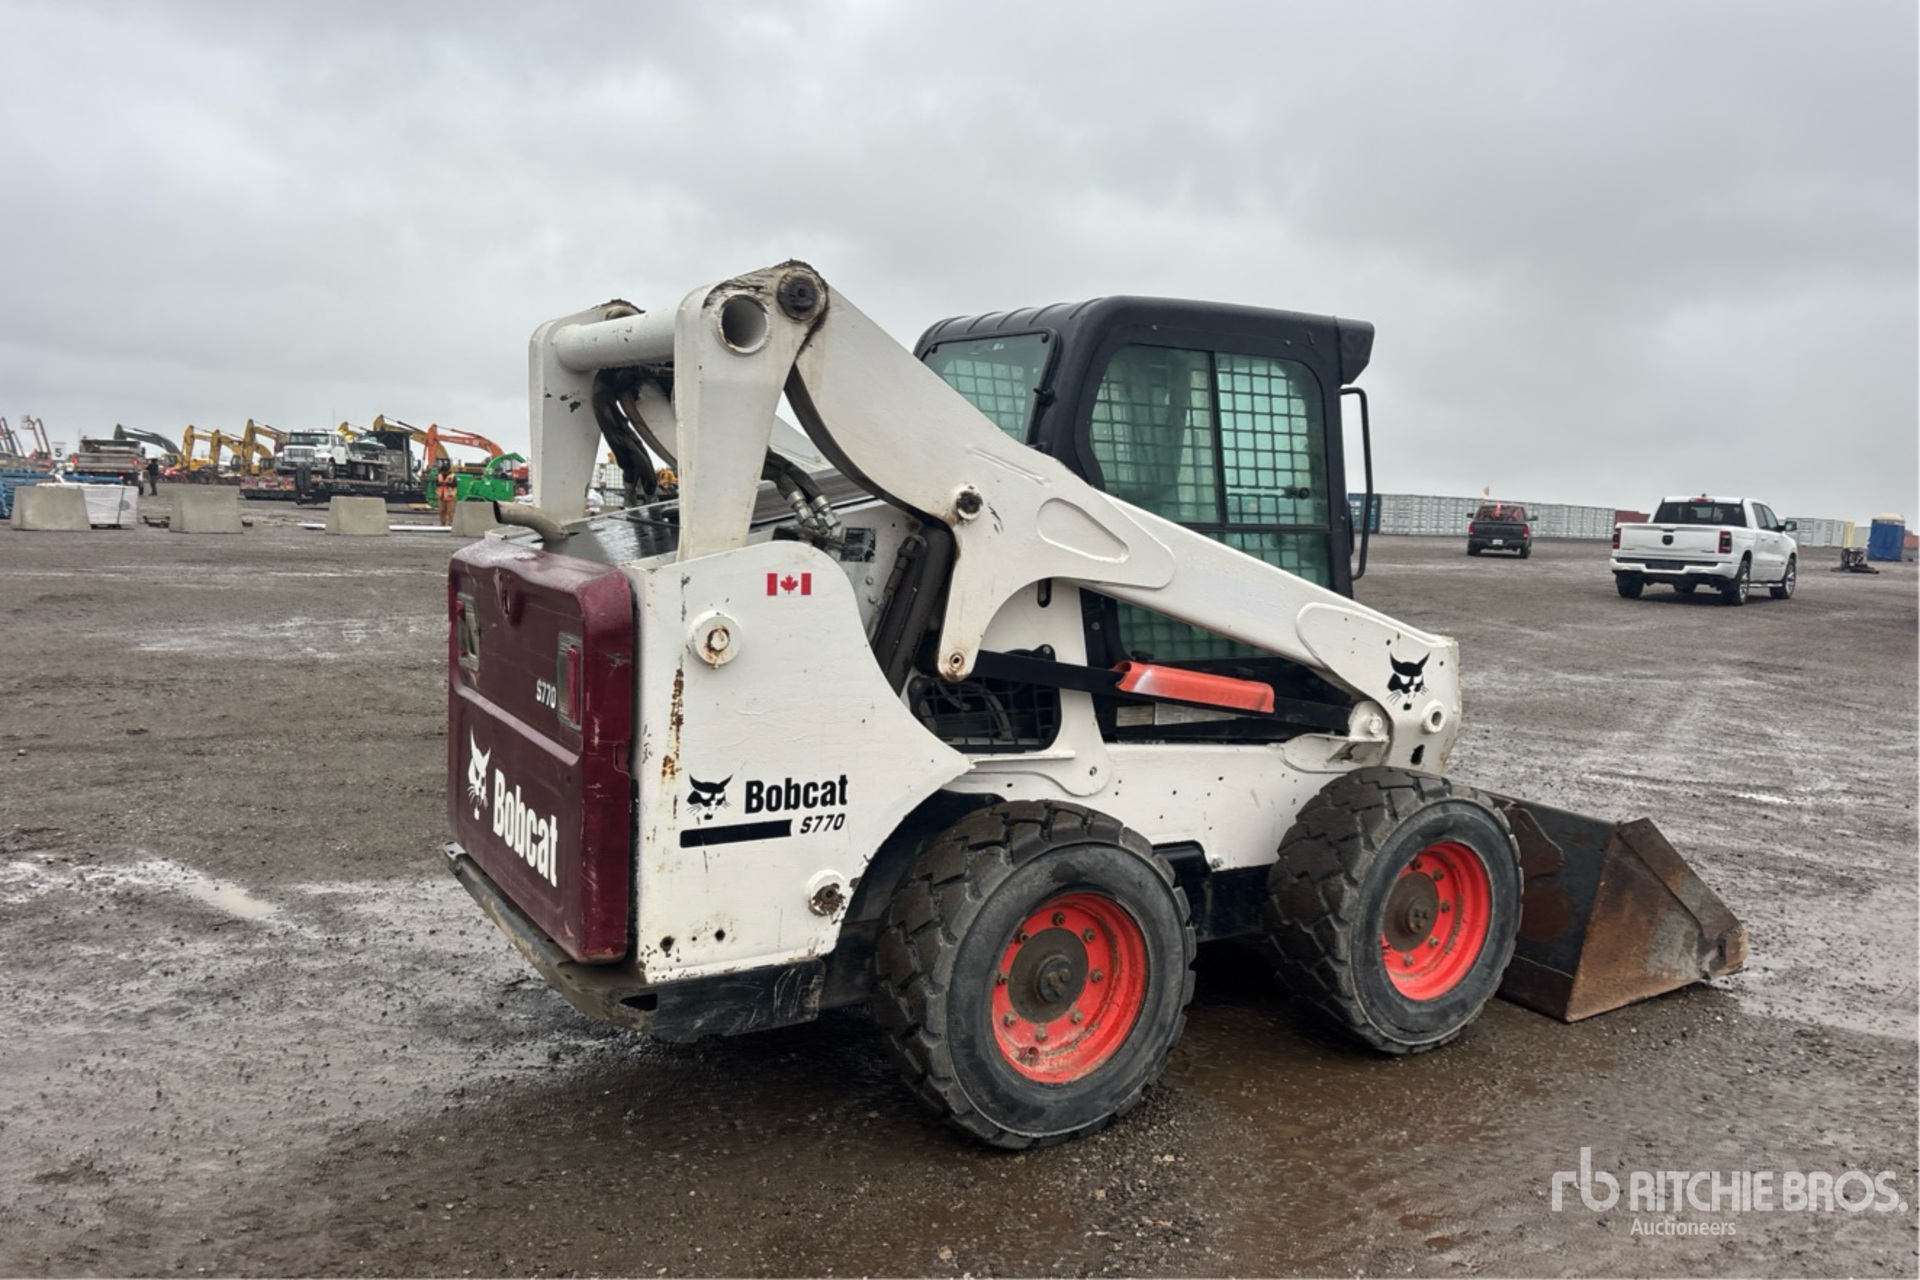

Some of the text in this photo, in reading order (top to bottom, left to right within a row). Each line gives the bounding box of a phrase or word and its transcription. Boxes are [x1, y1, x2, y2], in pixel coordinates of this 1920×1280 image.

[54, 447, 63, 458] 5
[536, 678, 557, 709] S770
[744, 774, 848, 815] Bobcat
[493, 767, 558, 888] Bobcat
[799, 813, 846, 834] S770
